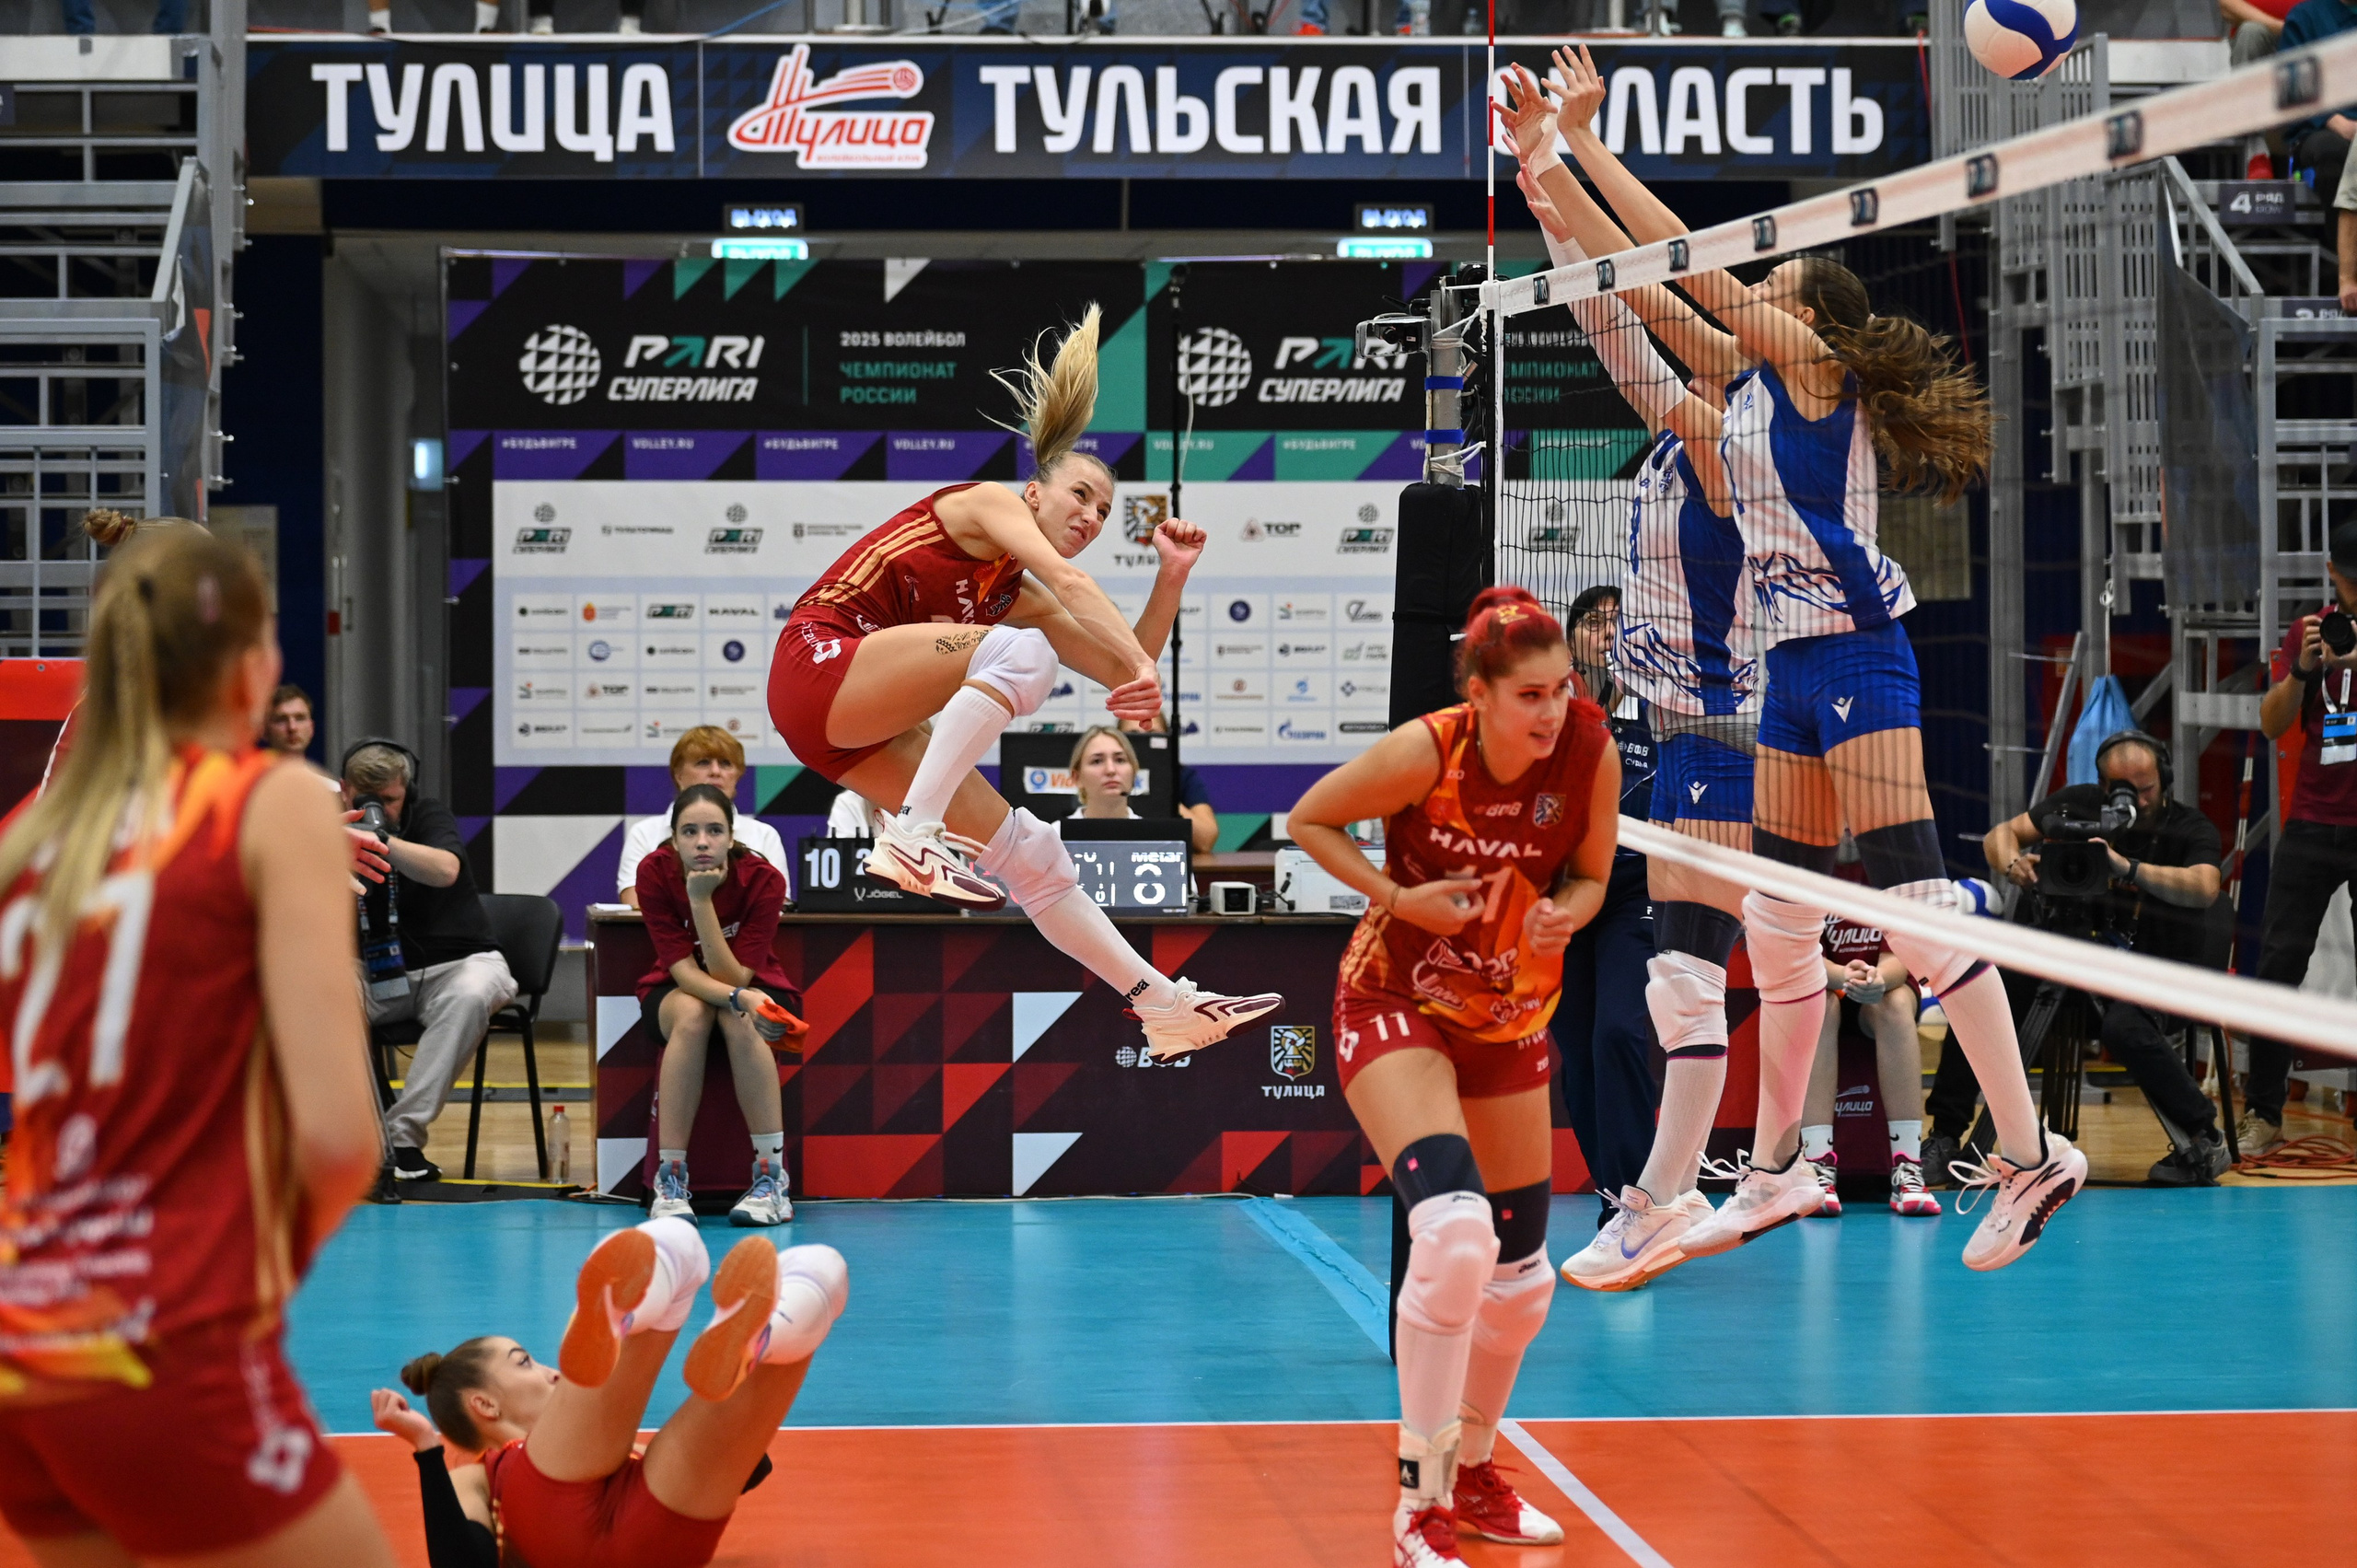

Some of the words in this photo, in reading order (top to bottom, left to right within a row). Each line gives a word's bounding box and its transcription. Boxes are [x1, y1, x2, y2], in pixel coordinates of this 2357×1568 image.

[310, 63, 676, 162] ТУЛИЦА
[979, 65, 1443, 154] ТУЛЬСКАЯ
[1492, 65, 1885, 155] ЛАСТЬ
[2229, 191, 2252, 215] 4
[839, 331, 880, 348] 2025
[883, 329, 966, 348] ВОЛЕЙБОЛ
[623, 334, 766, 369] PARI
[839, 361, 958, 379] ЧЕМПИОНАТ
[607, 376, 759, 401] СУПЕРЛИГА
[839, 387, 917, 403] РОССИИ
[1258, 377, 1407, 403] СУПЕРЛИГА
[632, 437, 694, 450] VOLLEY.RU
[893, 438, 956, 450] VOLLEY.RU
[1114, 554, 1162, 568] ТУЛИ
[1429, 827, 1542, 858] HAVAL
[805, 848, 841, 889] 10
[0, 869, 155, 1107] 27
[1369, 1011, 1411, 1041] 11
[1260, 1085, 1325, 1099] ТУЛИЦА
[1835, 1100, 1874, 1118] улица
